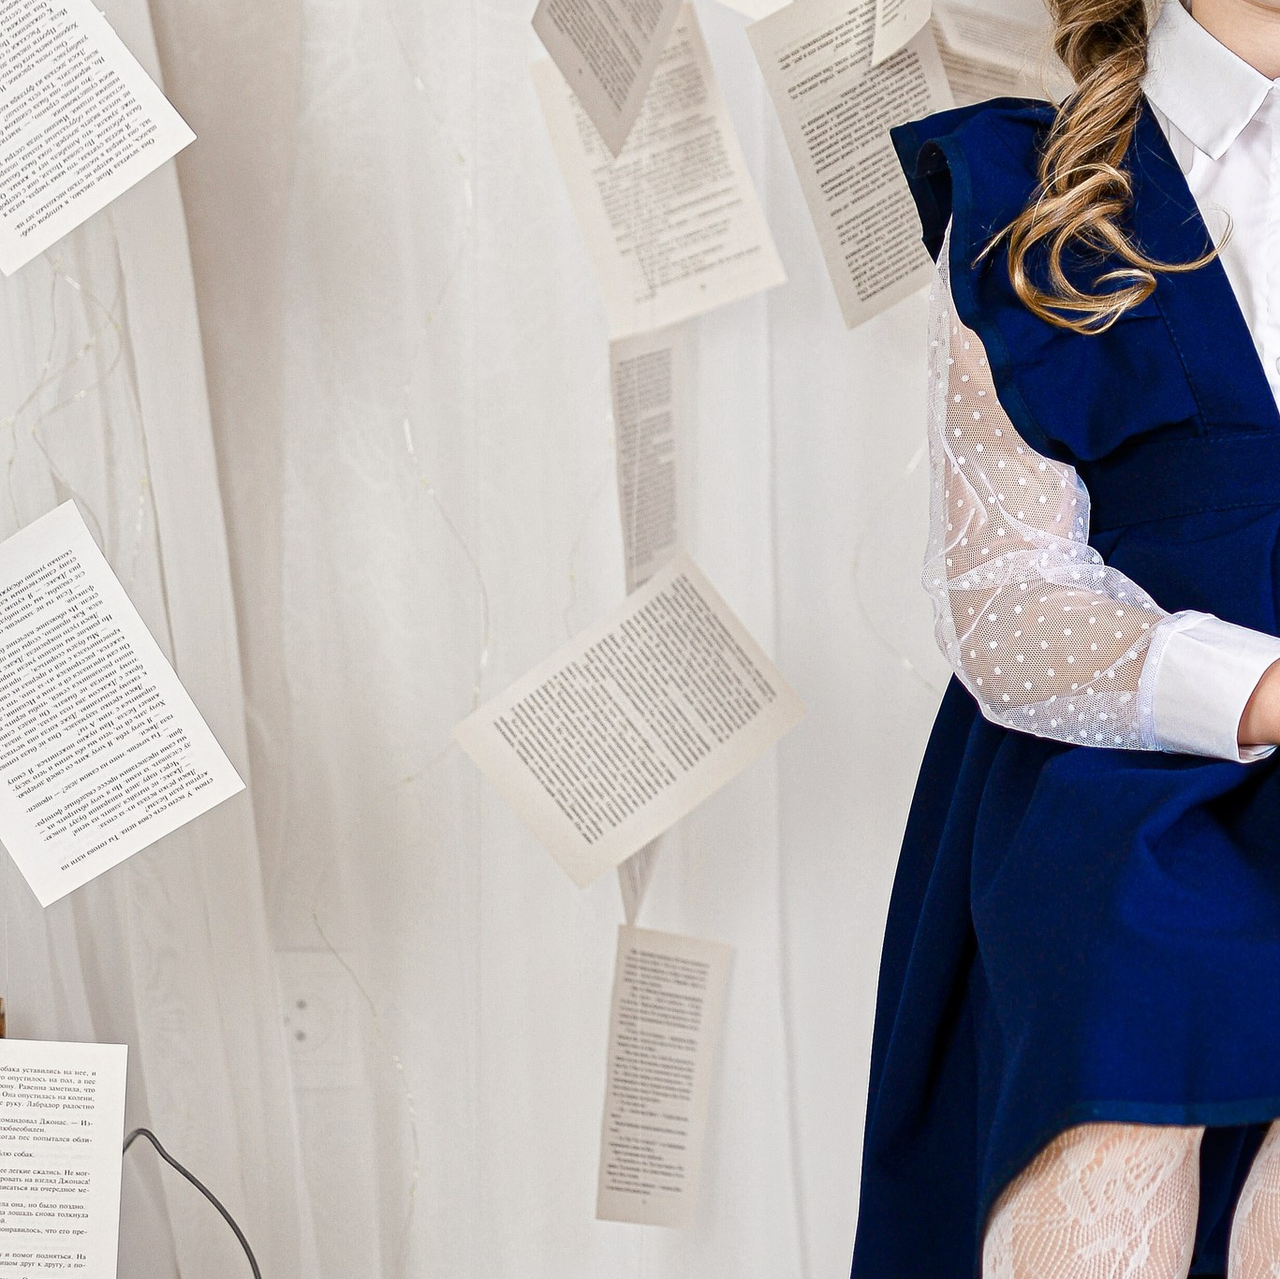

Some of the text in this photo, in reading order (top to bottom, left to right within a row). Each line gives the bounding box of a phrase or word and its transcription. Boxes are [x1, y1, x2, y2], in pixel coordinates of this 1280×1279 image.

[20, 1067, 61, 1075] уставились
[6, 1075, 47, 1085] опустилось
[18, 1083, 47, 1091] Равенна
[1, 1091, 17, 1100] Она
[16, 1091, 57, 1102] опустилась
[26, 1100, 61, 1109] Лабрадор
[80, 1119, 94, 1127] Из-
[7, 1168, 31, 1176] легкие
[57, 1177, 91, 1185] Джонаса!
[38, 1201, 58, 1209] было
[56, 1211, 89, 1219] толкнула
[19, 1259, 37, 1268] друг
